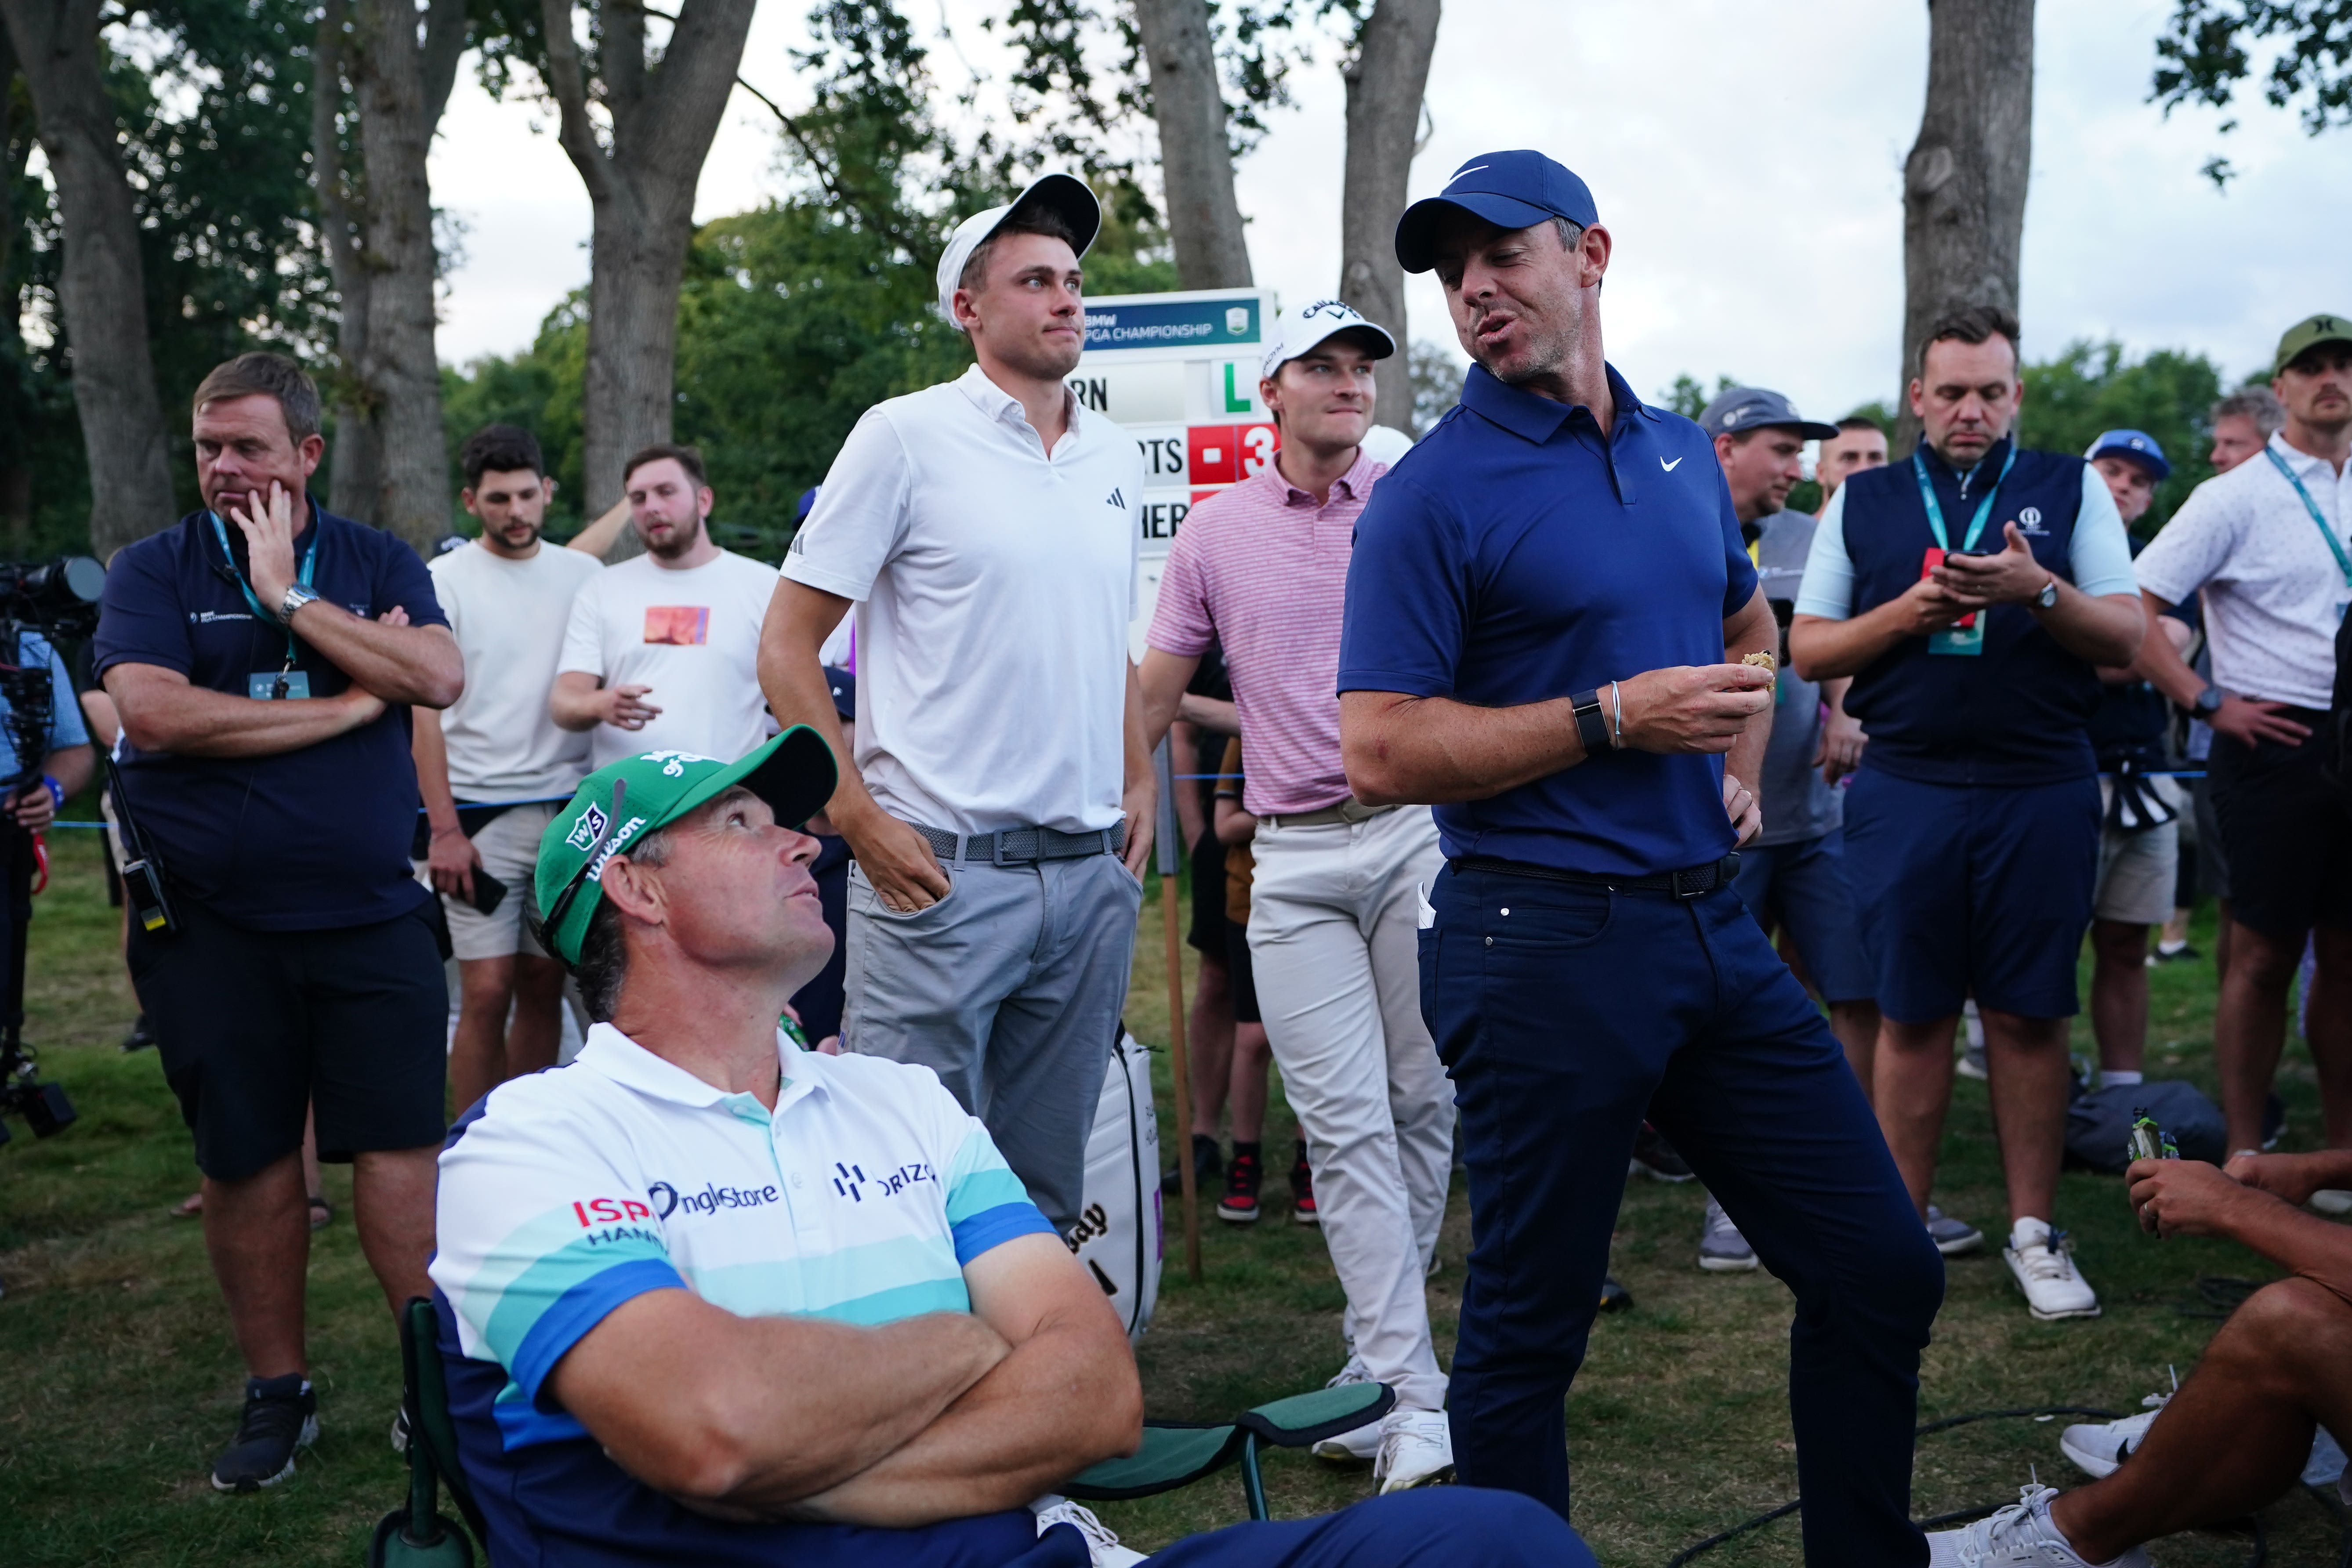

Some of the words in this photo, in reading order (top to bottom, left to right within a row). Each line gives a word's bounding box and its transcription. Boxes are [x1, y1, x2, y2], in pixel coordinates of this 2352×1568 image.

[1085, 314, 1117, 328] BMW
[1085, 328, 1111, 343] PGA
[1112, 323, 1214, 342] CHAMPIONSHIP
[1224, 362, 1251, 412] L
[573, 1198, 658, 1228] ISP
